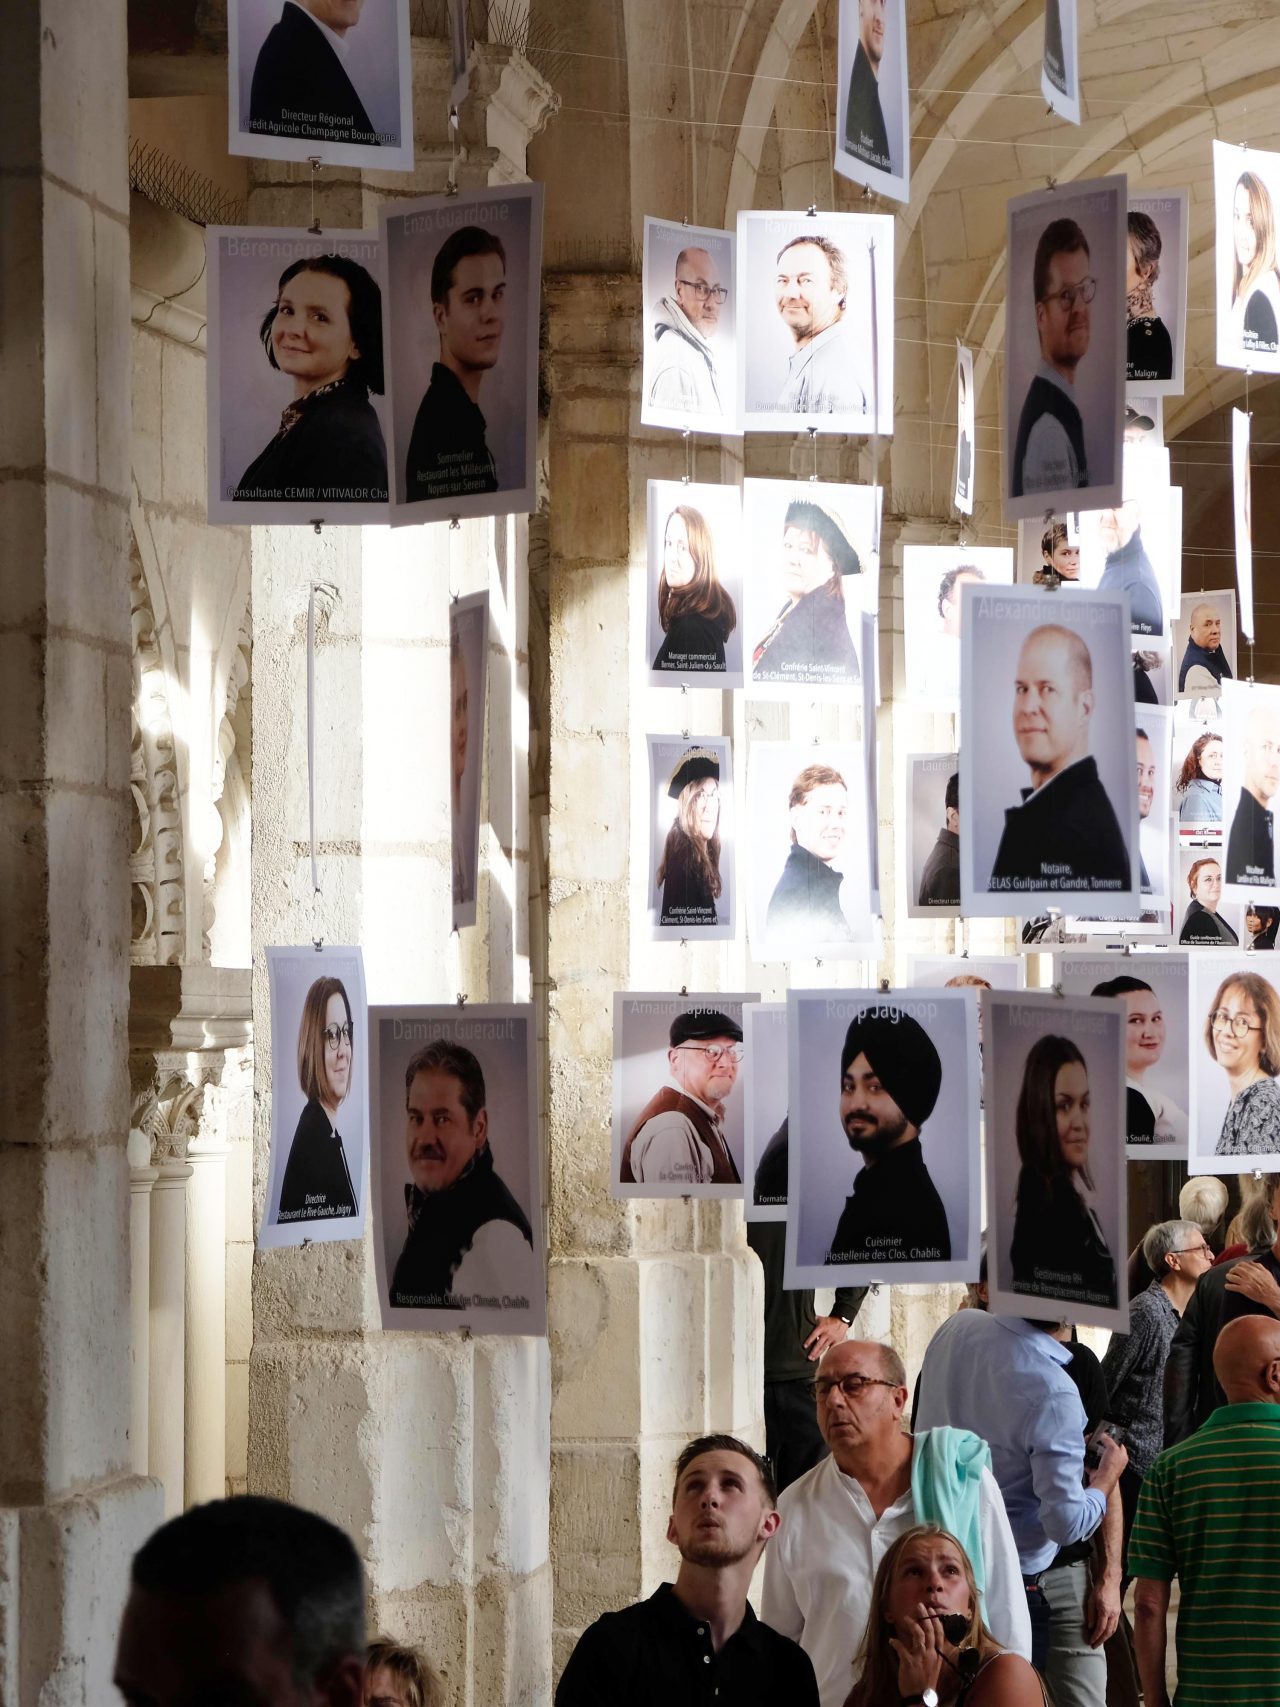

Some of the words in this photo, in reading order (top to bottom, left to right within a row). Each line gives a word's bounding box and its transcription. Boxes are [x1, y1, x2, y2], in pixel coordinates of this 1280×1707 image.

[282, 109, 317, 122] Directeur
[319, 113, 354, 128] Régional
[268, 122, 299, 134] Agricole
[301, 126, 349, 140] Champagne
[351, 130, 396, 144] Bourgogne
[1131, 198, 1172, 212] aroche
[404, 214, 433, 235] Enzo
[228, 237, 323, 261] Bérengère
[227, 486, 282, 499] Consultante
[284, 487, 315, 499] CEMIR
[322, 487, 368, 499] VITIVALOR
[979, 596, 1055, 620] Alexandre
[1061, 599, 1118, 623] Guilpain
[668, 652, 688, 662] Manager
[689, 652, 717, 661] commercial
[1040, 862, 1072, 876] Notaire,
[1013, 877, 1049, 892] Guilpain
[1050, 878, 1057, 888] et
[1059, 877, 1089, 890] Gandré,
[1090, 878, 1121, 889] Tonnerre
[1064, 961, 1111, 974] Océane
[631, 1000, 676, 1015] Arnaud
[680, 1001, 743, 1019] Laplanche
[826, 999, 866, 1024] Roop
[871, 1001, 937, 1024] Jagroop
[393, 1018, 450, 1041] Damien
[454, 1017, 515, 1041] Guerault
[305, 1193, 326, 1205] Directrice
[301, 1208, 307, 1218] Le
[307, 1207, 317, 1218] Rive
[317, 1206, 336, 1217] Gauche,
[336, 1205, 352, 1217] Joigny
[865, 1236, 903, 1248] Cuisinier
[825, 1250, 870, 1262] Hostellerie
[872, 1249, 887, 1261] des
[888, 1249, 908, 1261] Clos,
[910, 1247, 941, 1259] Chablis
[396, 1291, 442, 1305] Responsable
[1041, 1283, 1087, 1299] Remplacement
